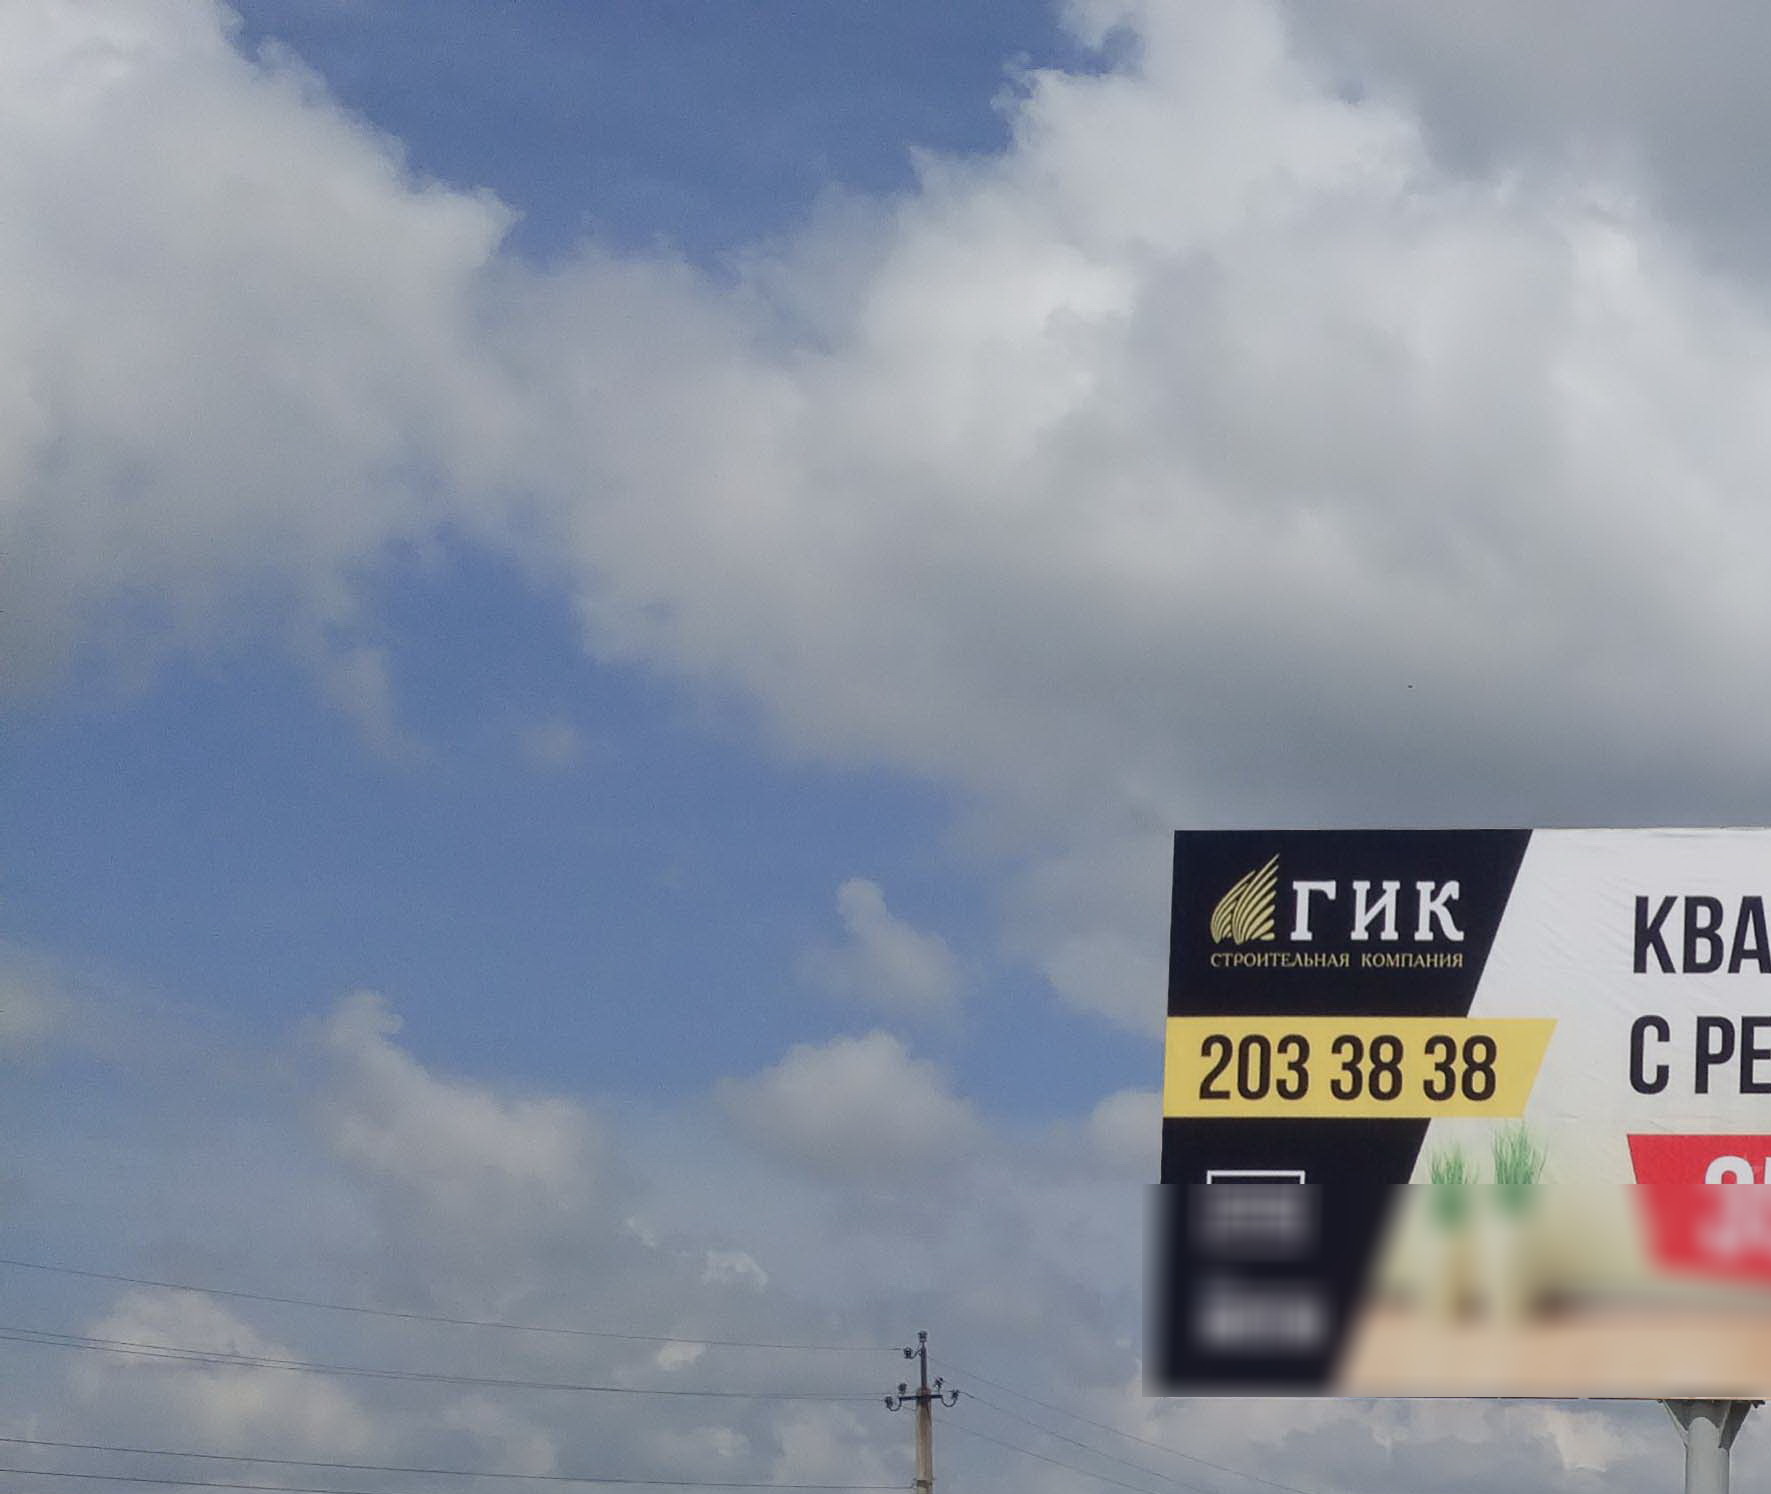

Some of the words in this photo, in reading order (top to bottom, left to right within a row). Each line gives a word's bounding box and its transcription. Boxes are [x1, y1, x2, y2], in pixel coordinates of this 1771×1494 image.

[1290, 880, 1465, 942] ГИК
[1210, 951, 1350, 969] СТРОИТЕЛЬНАЯ
[1361, 951, 1464, 969] КОМПАНИЯ
[1199, 1033, 1311, 1102] 203
[1330, 1033, 1405, 1102] 38
[1422, 1034, 1498, 1103] 38
[1629, 1014, 1671, 1095] С
